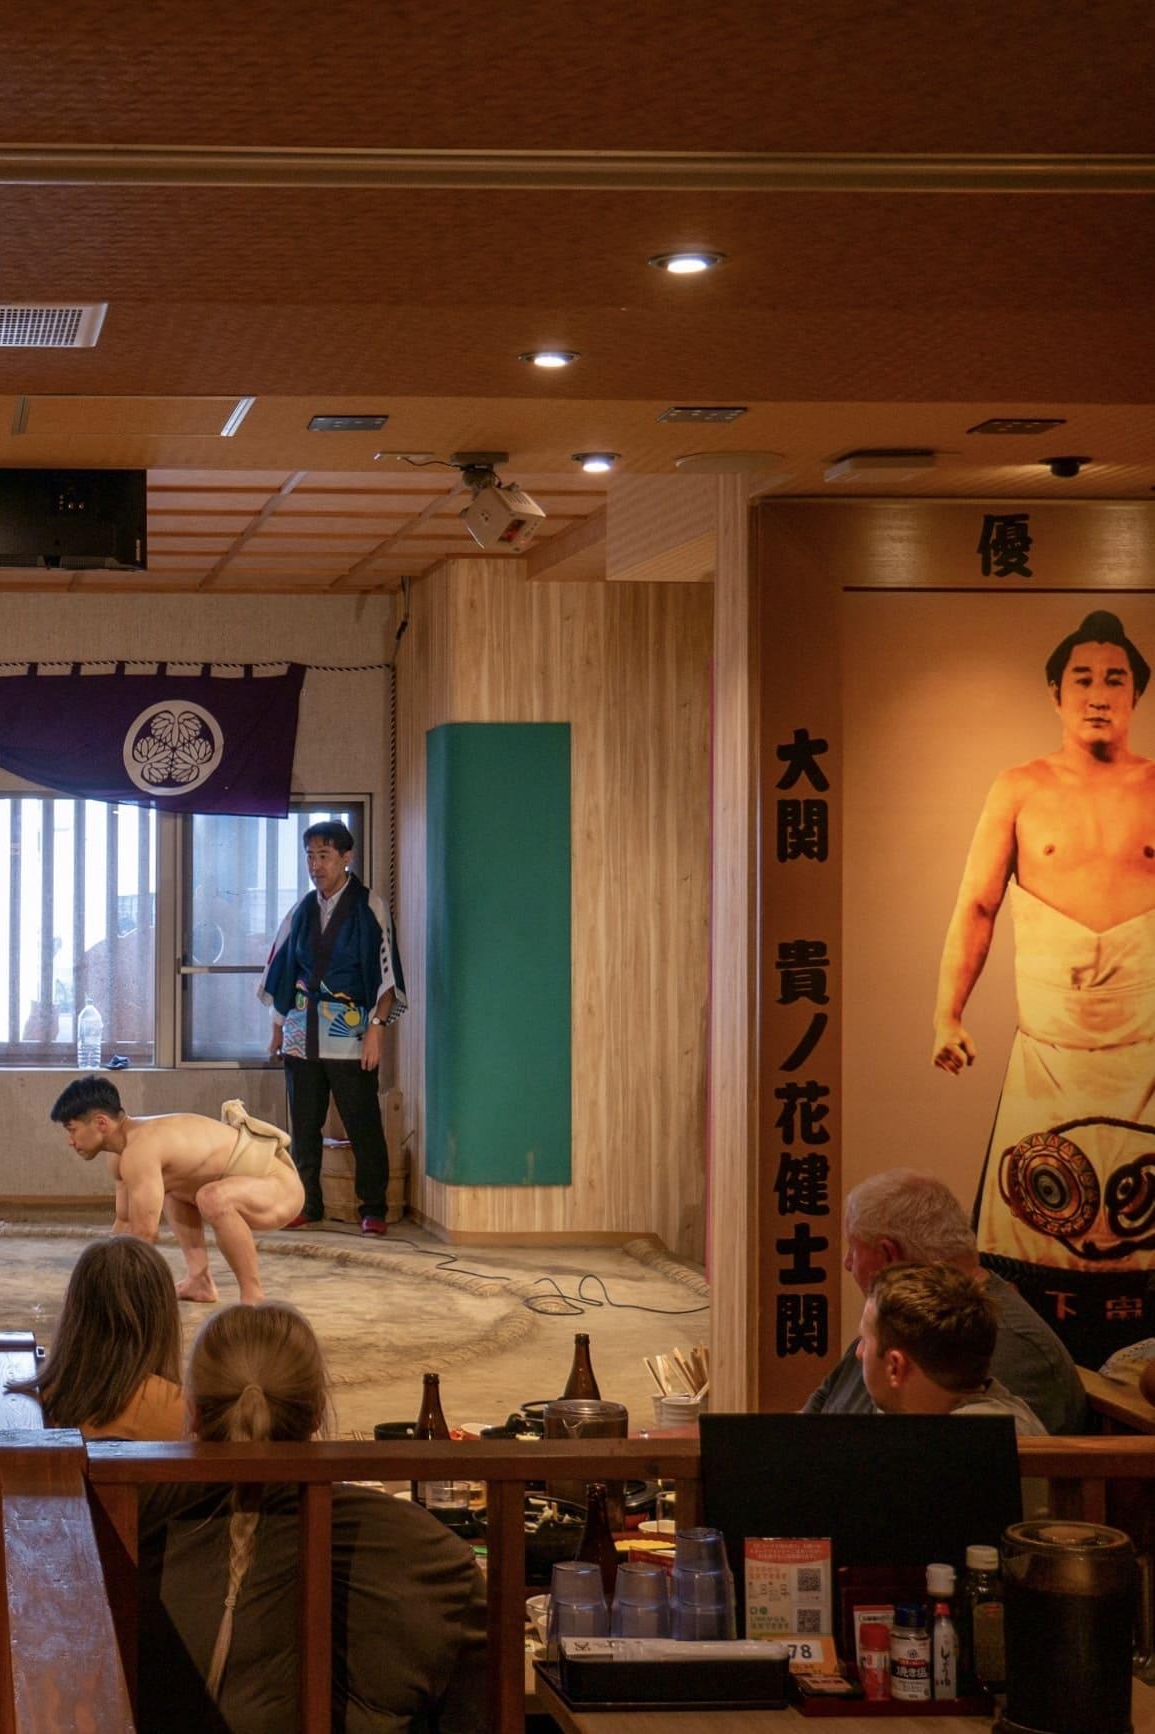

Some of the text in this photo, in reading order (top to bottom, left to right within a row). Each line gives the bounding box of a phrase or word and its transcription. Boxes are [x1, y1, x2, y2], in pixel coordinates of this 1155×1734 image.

[976, 514, 1033, 578] 優
[774, 728, 830, 862] 大関
[773, 940, 831, 1358] 貴ノ花健士関
